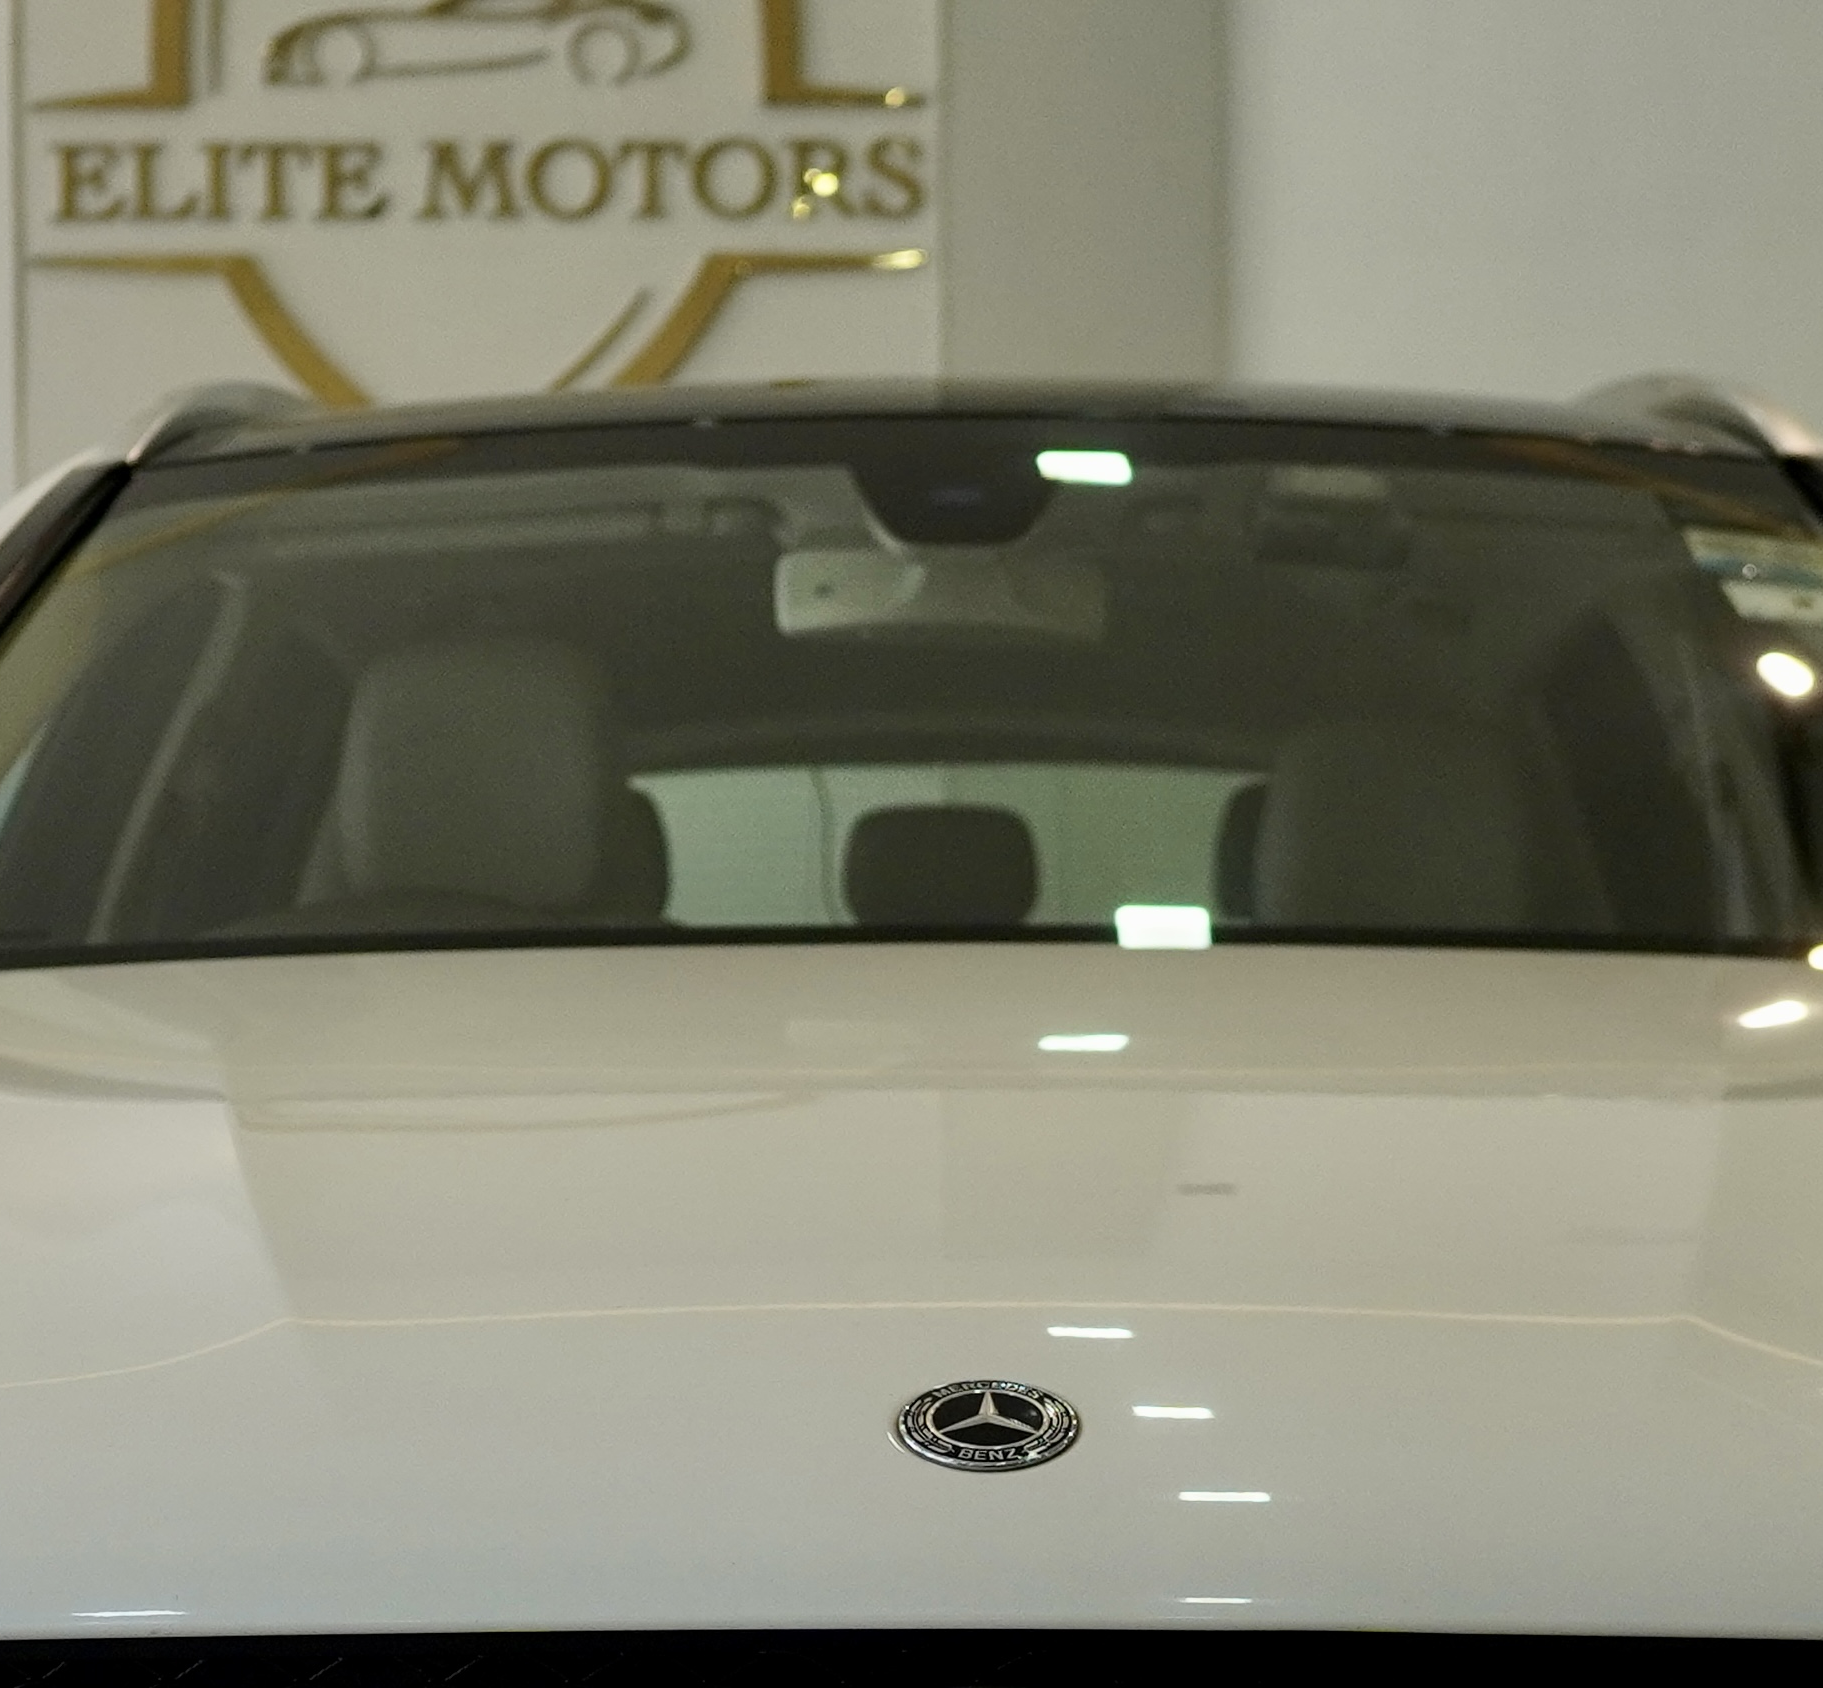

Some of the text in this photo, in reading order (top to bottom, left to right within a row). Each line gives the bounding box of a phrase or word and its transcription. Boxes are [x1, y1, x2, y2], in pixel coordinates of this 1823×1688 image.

[51, 136, 929, 224] ELITE MOTORS
[957, 1448, 1020, 1461] BENZ
